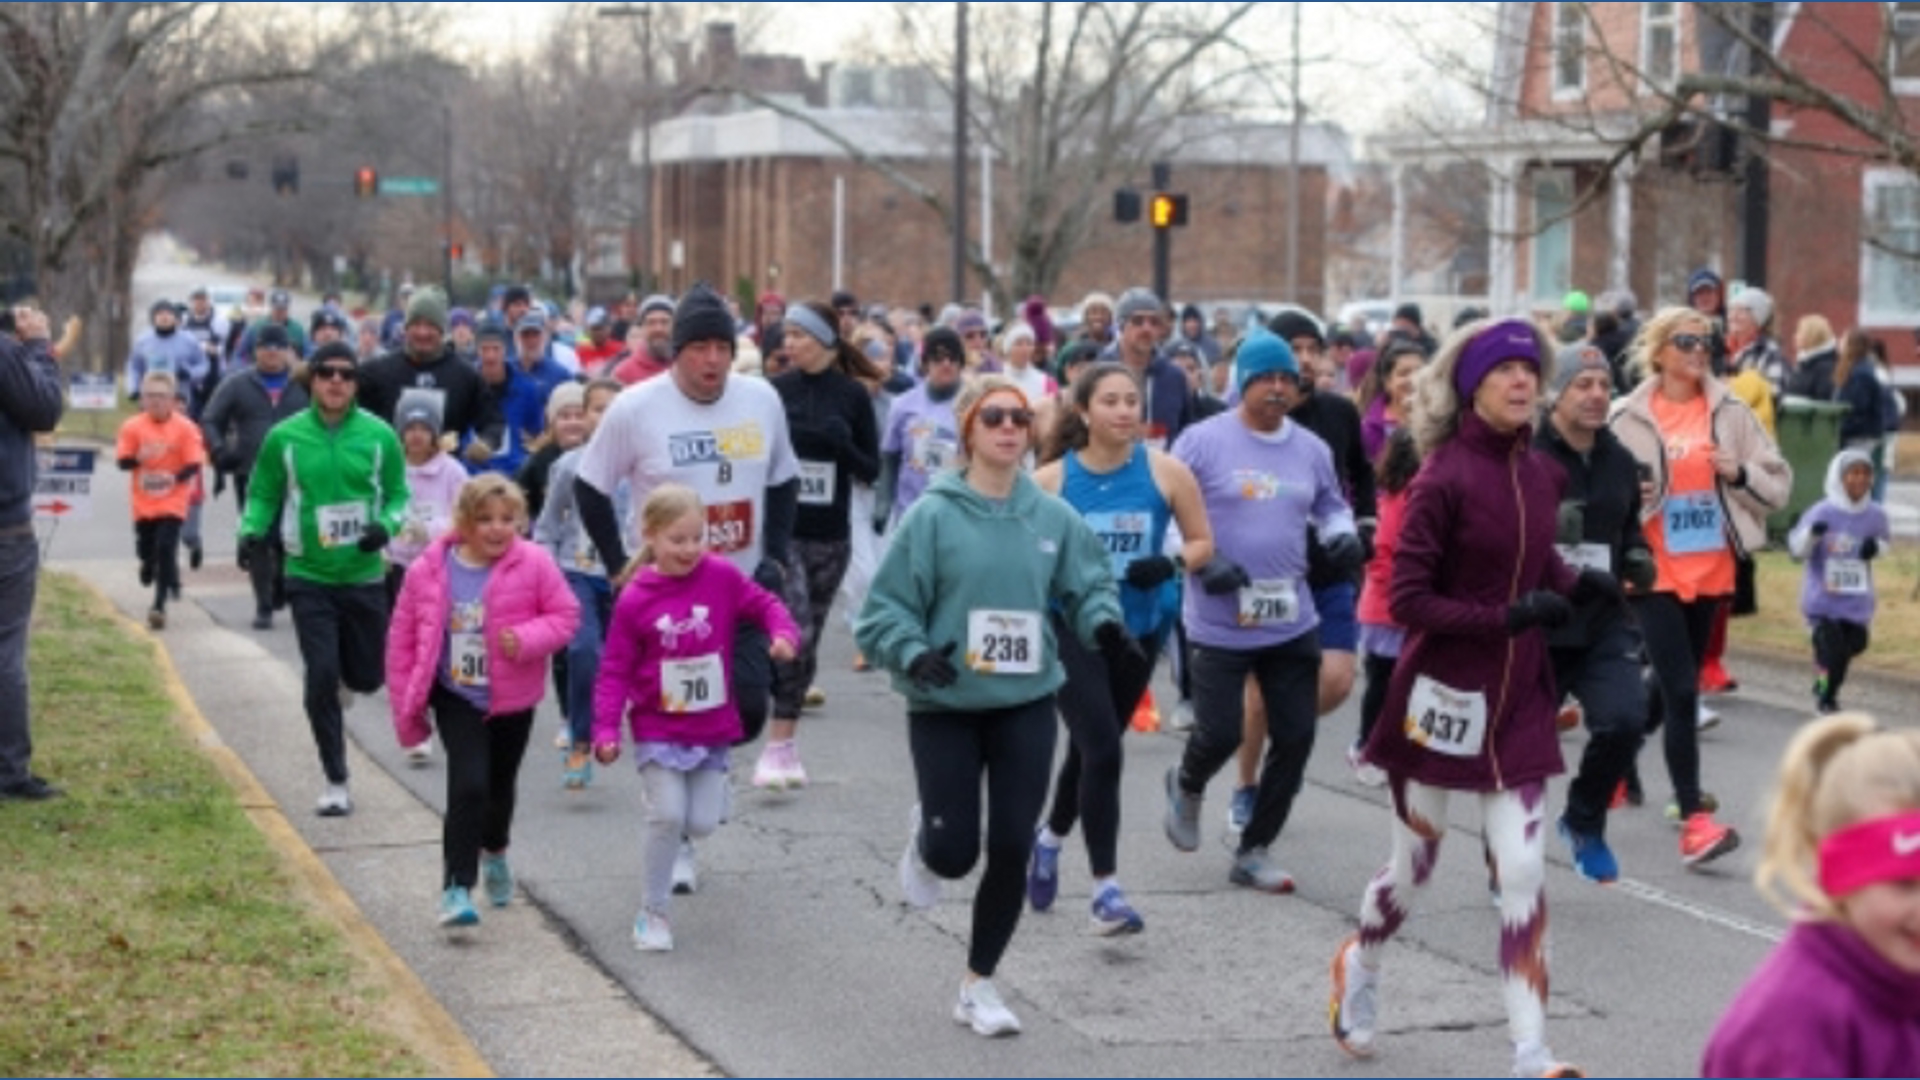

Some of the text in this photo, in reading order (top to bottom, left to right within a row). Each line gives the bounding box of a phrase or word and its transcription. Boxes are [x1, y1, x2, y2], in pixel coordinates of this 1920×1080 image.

[982, 634, 1029, 662] 238
[680, 677, 709, 703] 70
[1419, 708, 1470, 744] 437
